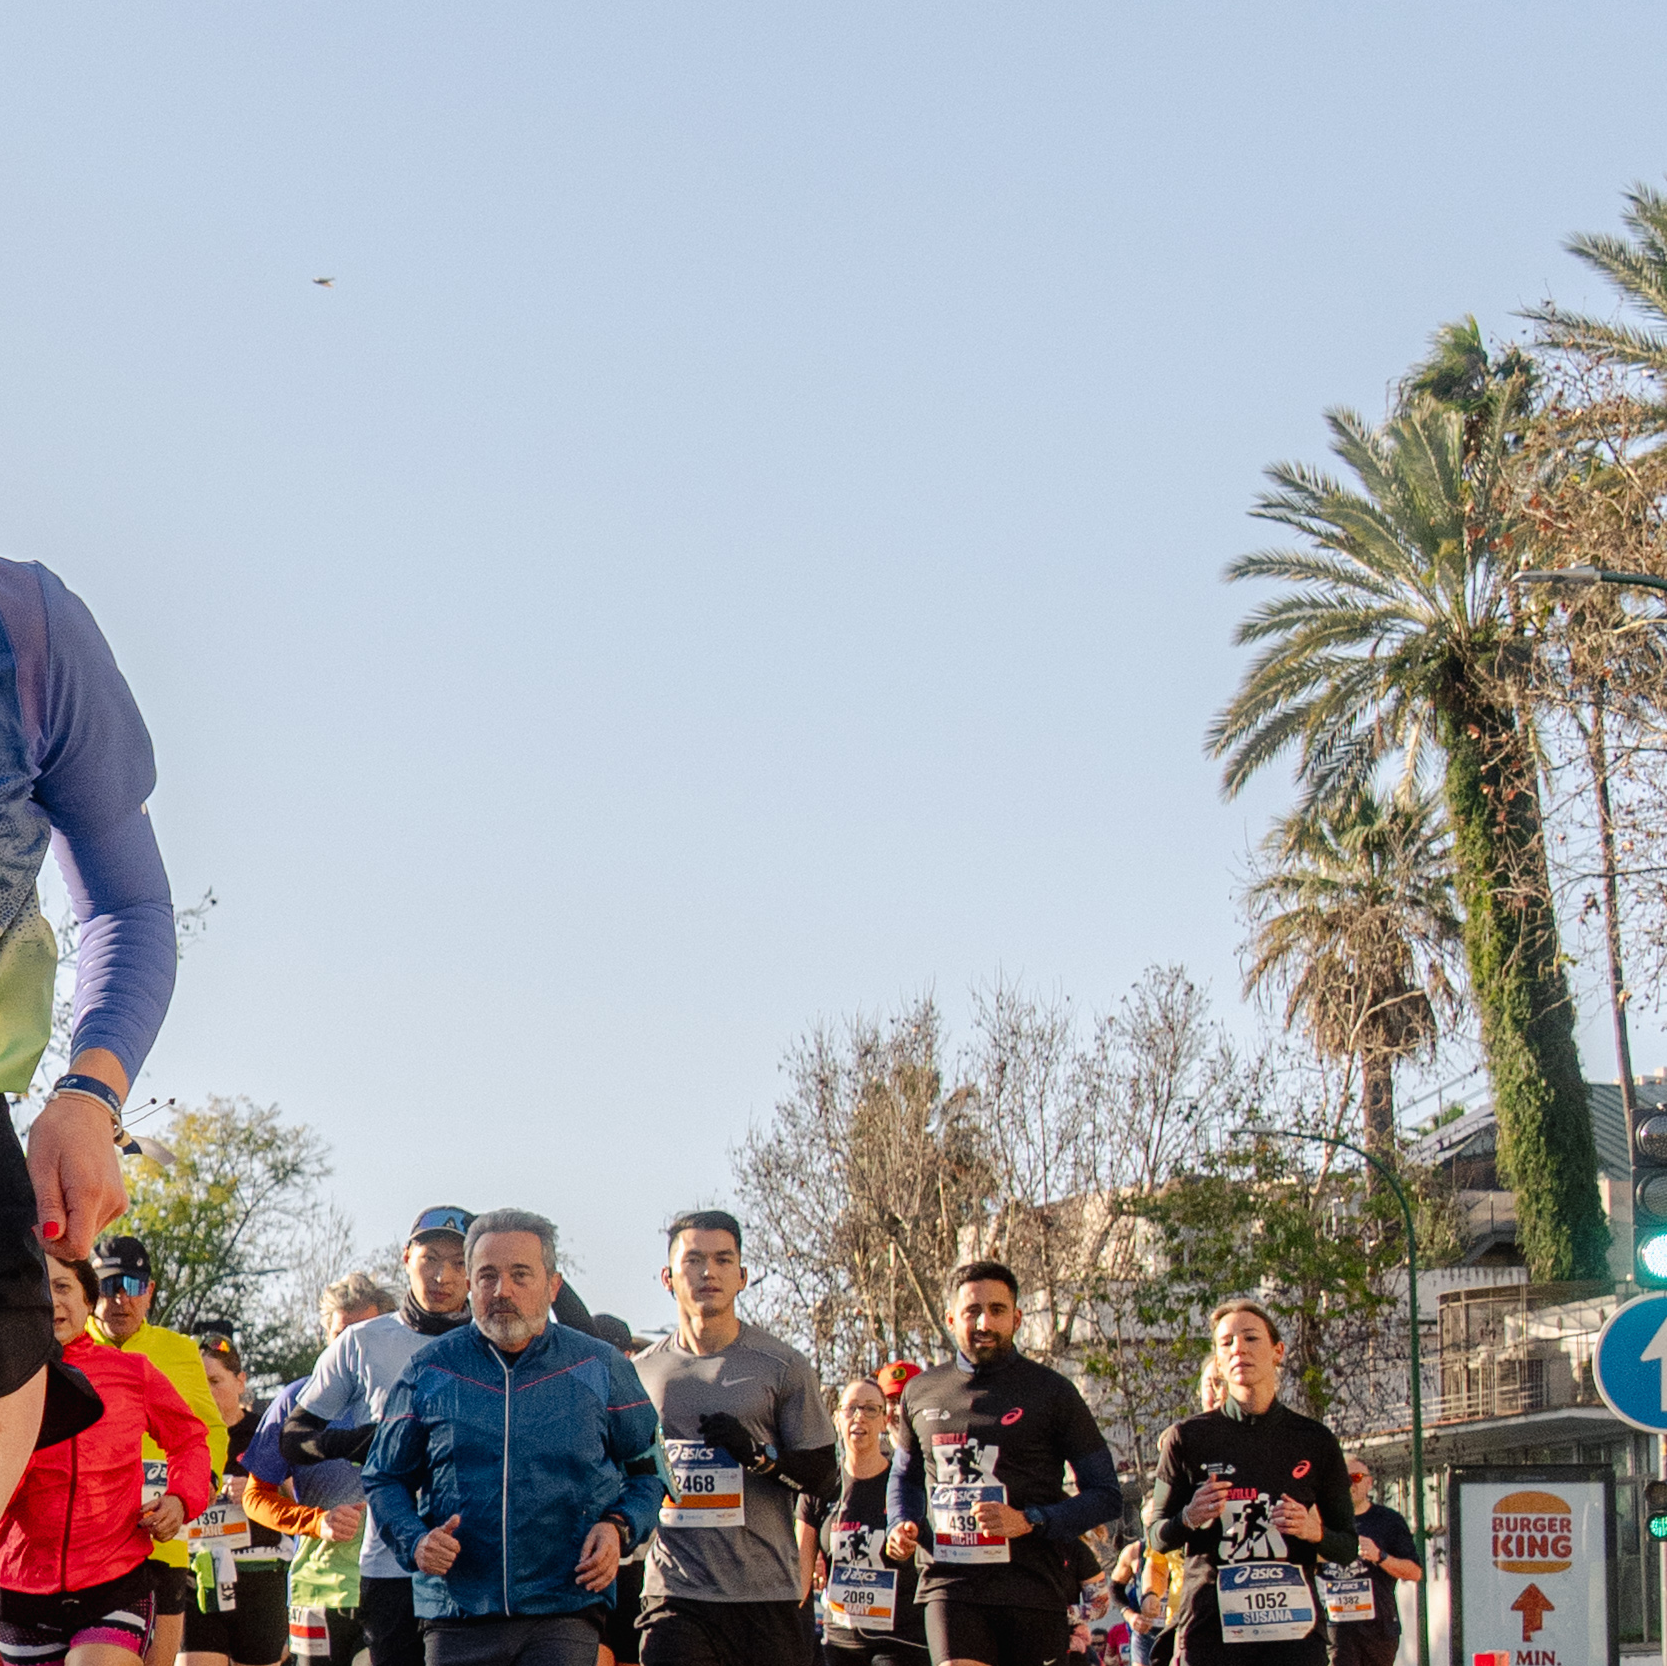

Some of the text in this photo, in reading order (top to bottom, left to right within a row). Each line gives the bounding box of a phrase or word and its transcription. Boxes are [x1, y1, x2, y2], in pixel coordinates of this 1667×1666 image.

[1491, 1516, 1572, 1533] BURGER
[1491, 1534, 1573, 1558] KING
[843, 1590, 875, 1605] 2089
[1244, 1591, 1288, 1611] 1052
[1338, 1595, 1360, 1605] 1382
[1242, 1609, 1294, 1625] SUSANA
[1515, 1650, 1562, 1666] MIN.
